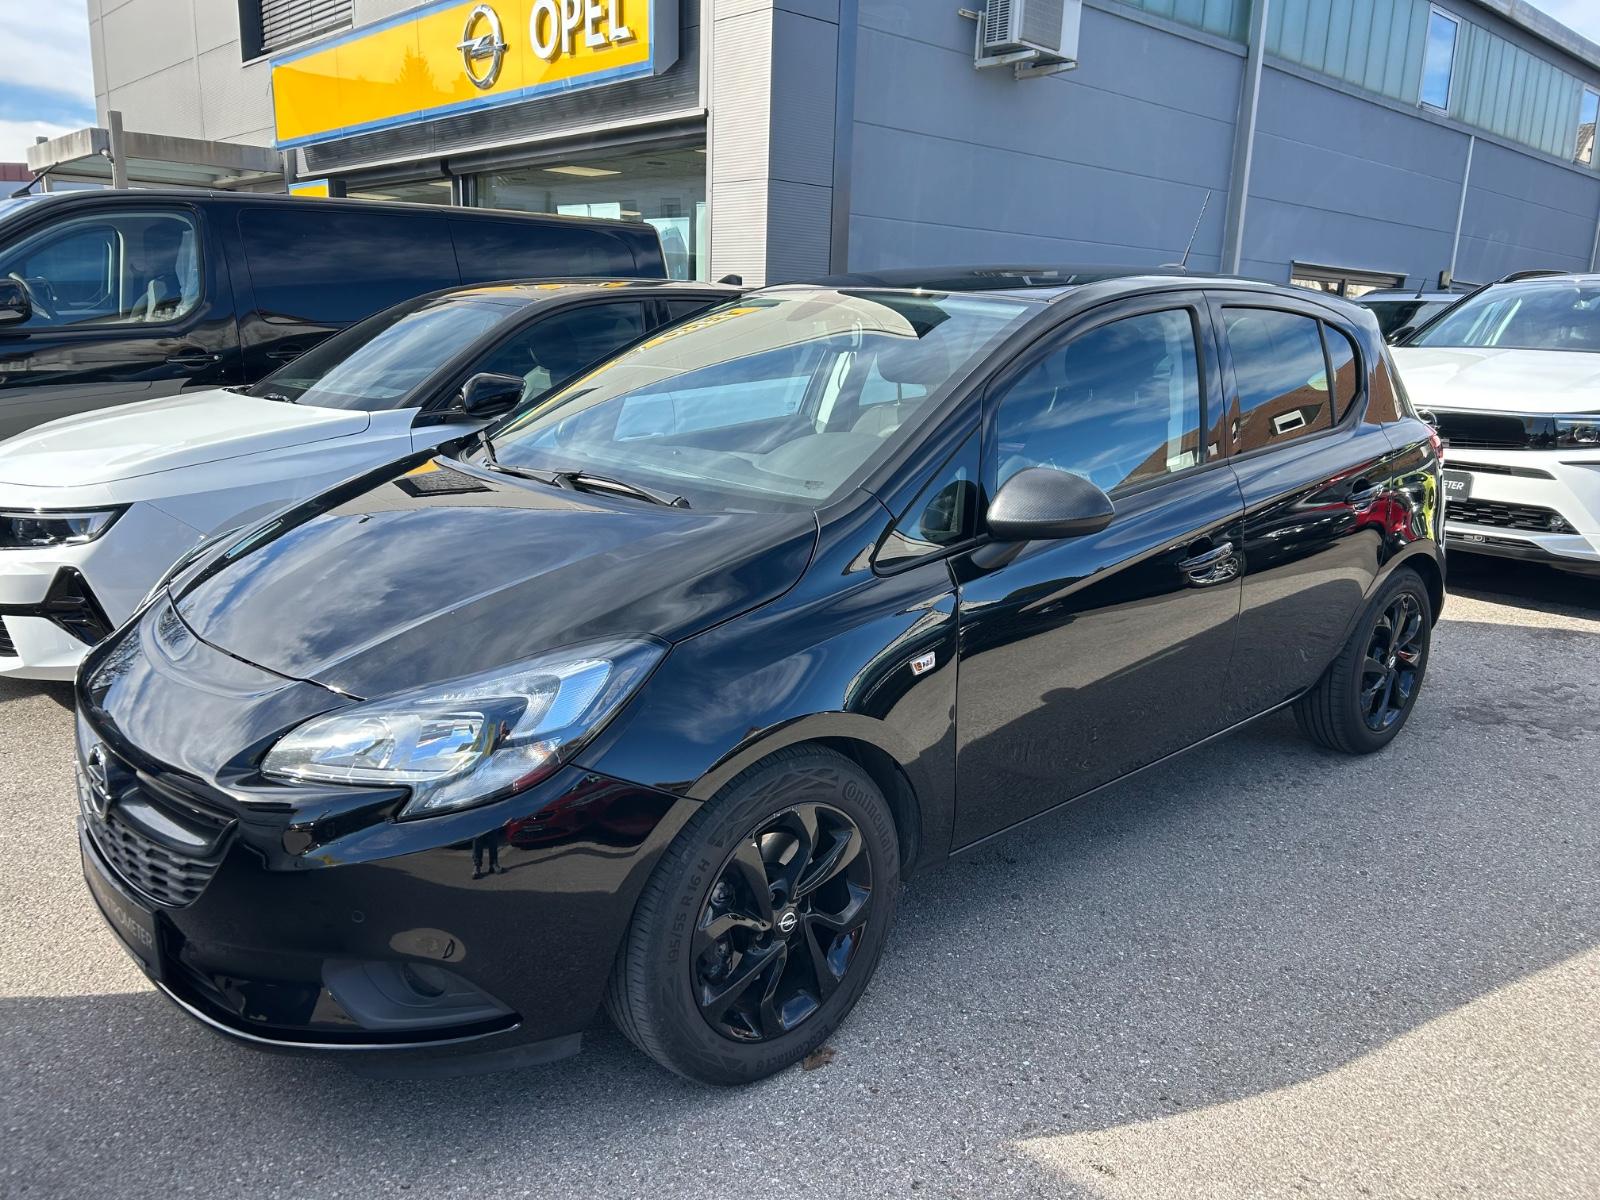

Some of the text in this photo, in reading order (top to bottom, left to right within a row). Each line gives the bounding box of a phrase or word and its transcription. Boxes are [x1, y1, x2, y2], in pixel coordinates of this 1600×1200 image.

[530, 0, 632, 59] OPEL
[842, 779, 894, 854] Continental
[667, 858, 711, 966] 195/55 R 16 H
